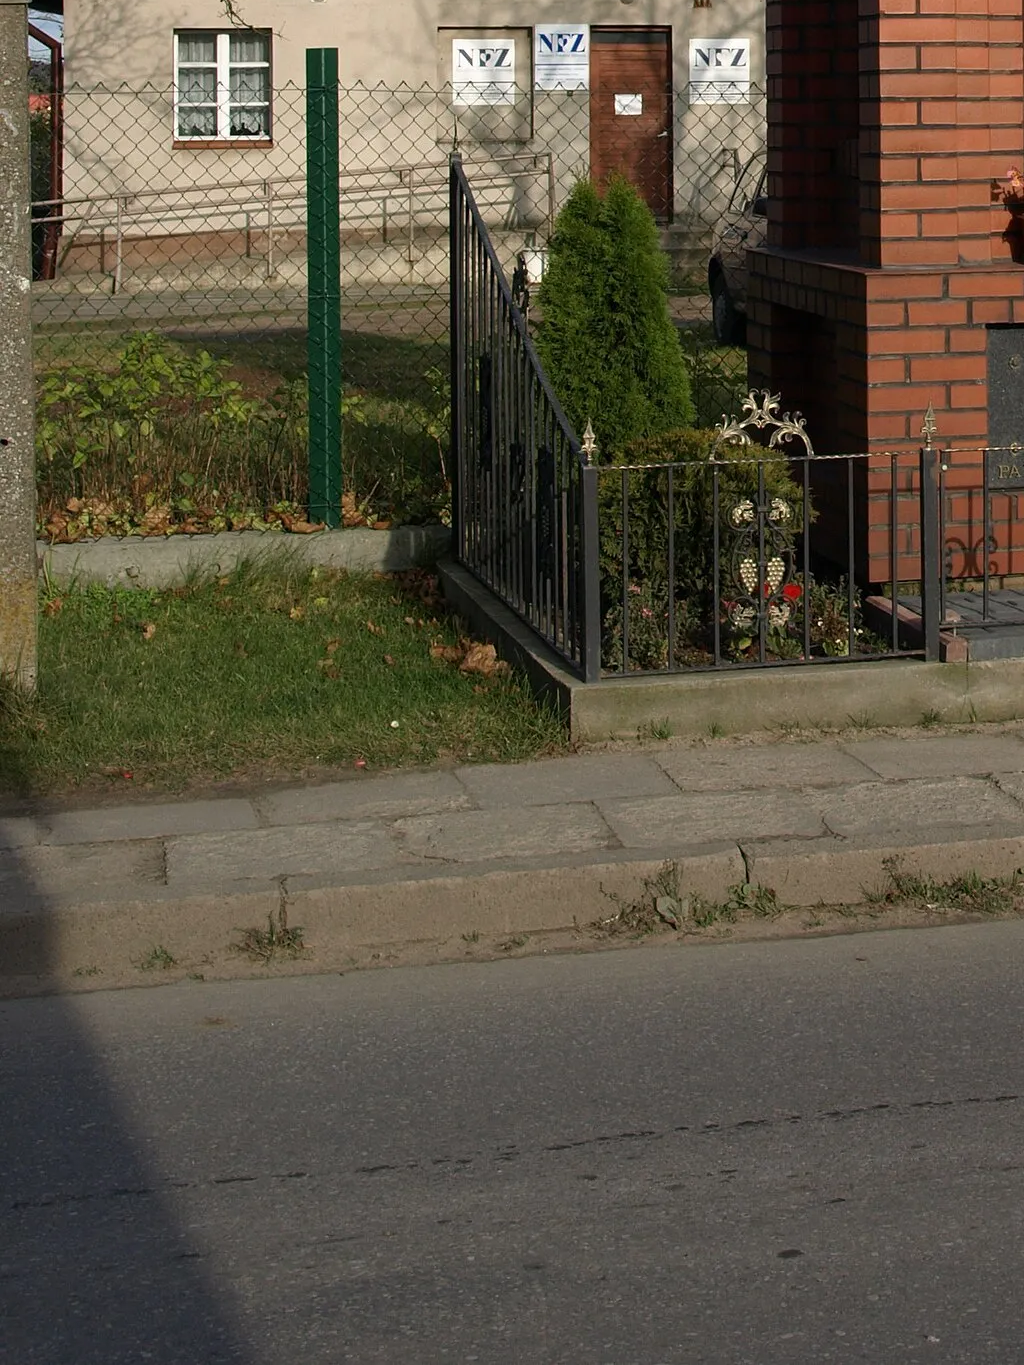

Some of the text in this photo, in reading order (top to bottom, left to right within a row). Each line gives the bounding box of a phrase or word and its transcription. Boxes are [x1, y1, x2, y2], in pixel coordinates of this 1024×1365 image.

[538, 33, 585, 52] NFZ
[457, 48, 511, 67] NFZ
[695, 48, 746, 67] NFZ
